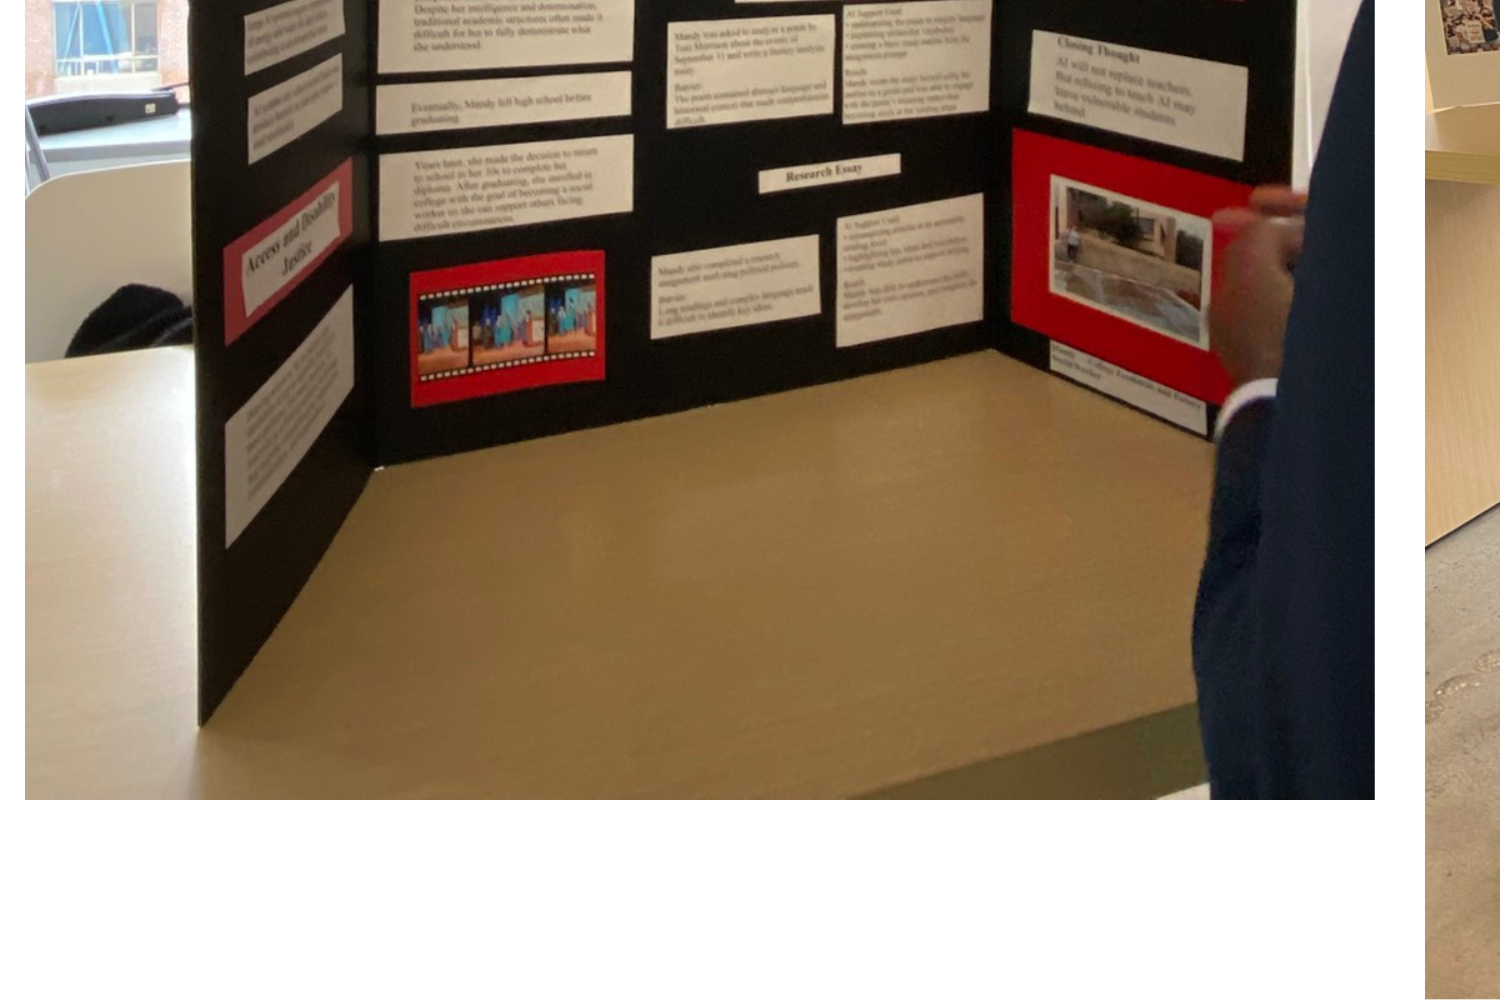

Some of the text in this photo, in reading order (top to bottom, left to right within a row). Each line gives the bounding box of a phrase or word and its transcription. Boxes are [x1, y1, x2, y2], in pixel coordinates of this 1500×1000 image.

[1057, 36, 1141, 64] Closing Thought
[786, 162, 863, 184] Research Essay
[245, 192, 337, 276] Access and Disability
[282, 241, 313, 276] Justice
